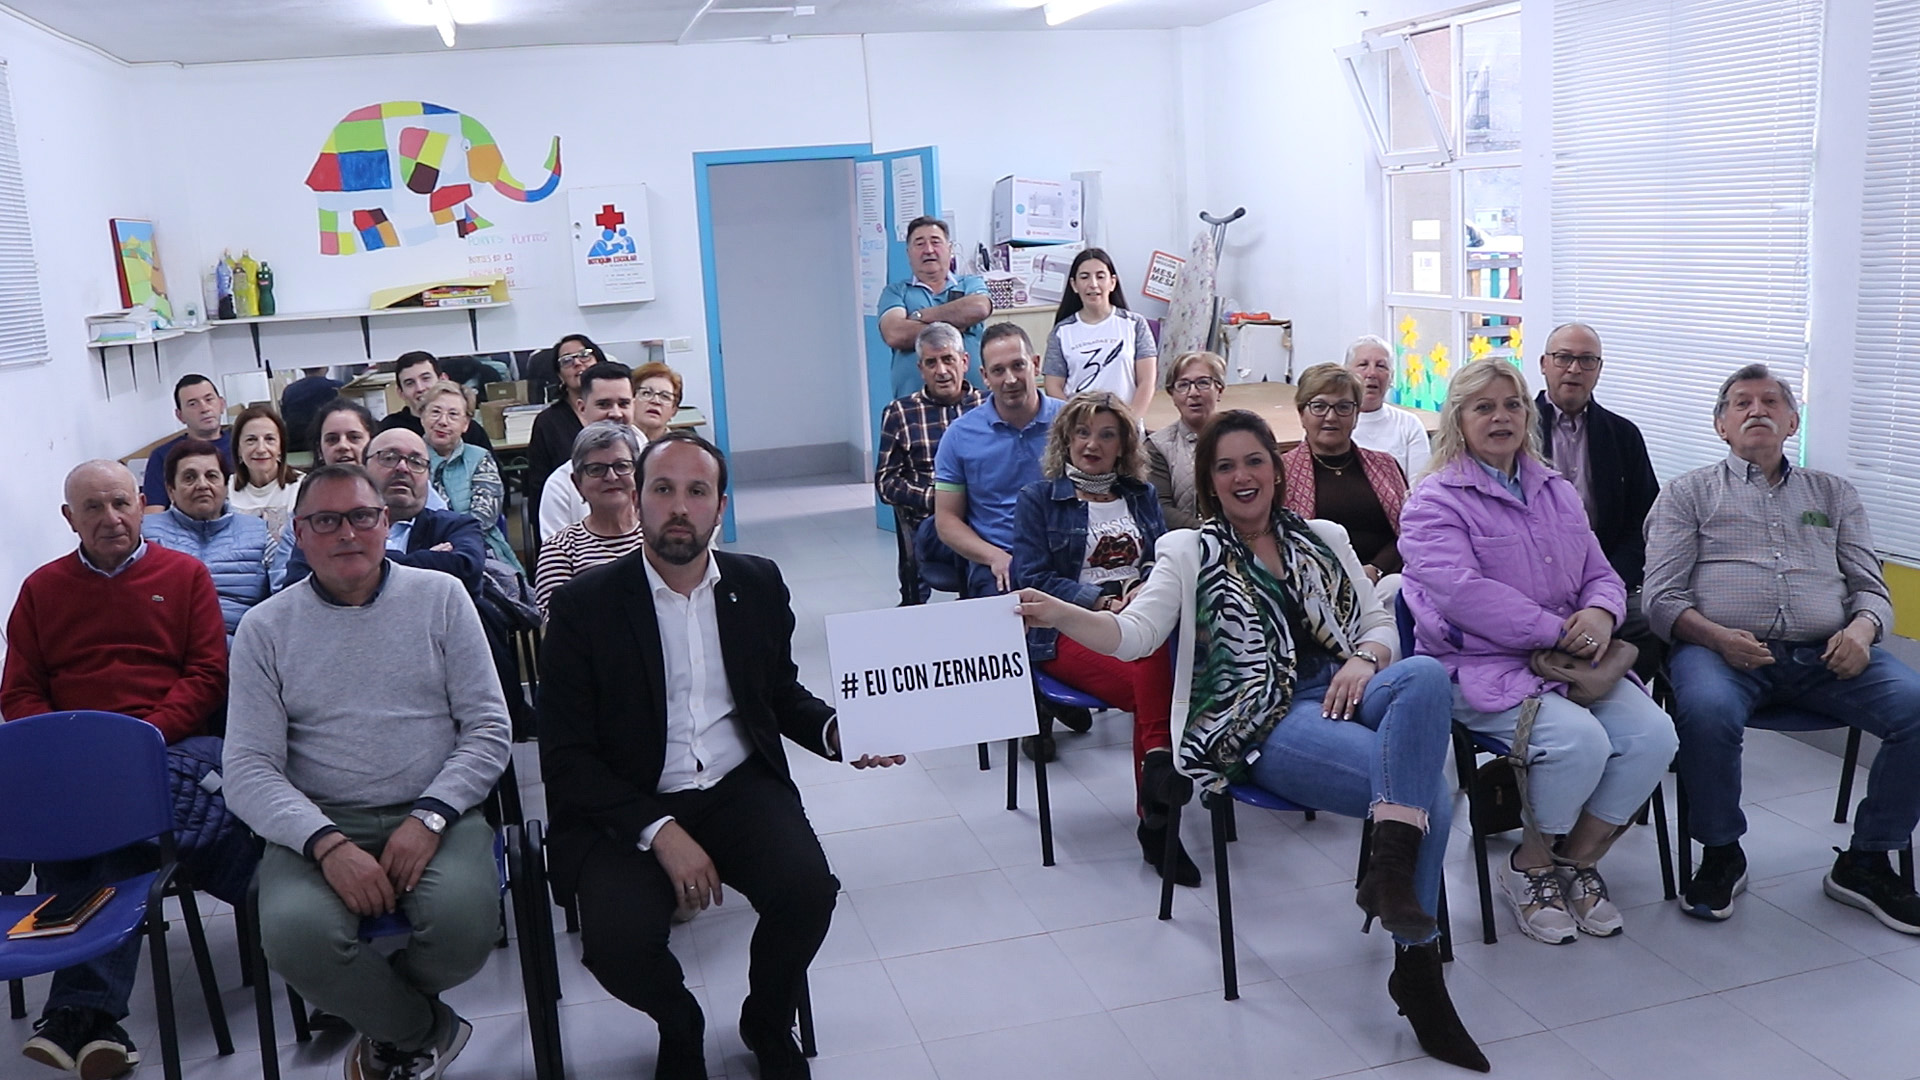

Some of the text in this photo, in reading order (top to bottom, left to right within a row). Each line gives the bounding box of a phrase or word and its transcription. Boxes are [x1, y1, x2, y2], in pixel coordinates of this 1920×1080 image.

[841, 651, 1024, 700] # EU CON ZERNADAS
